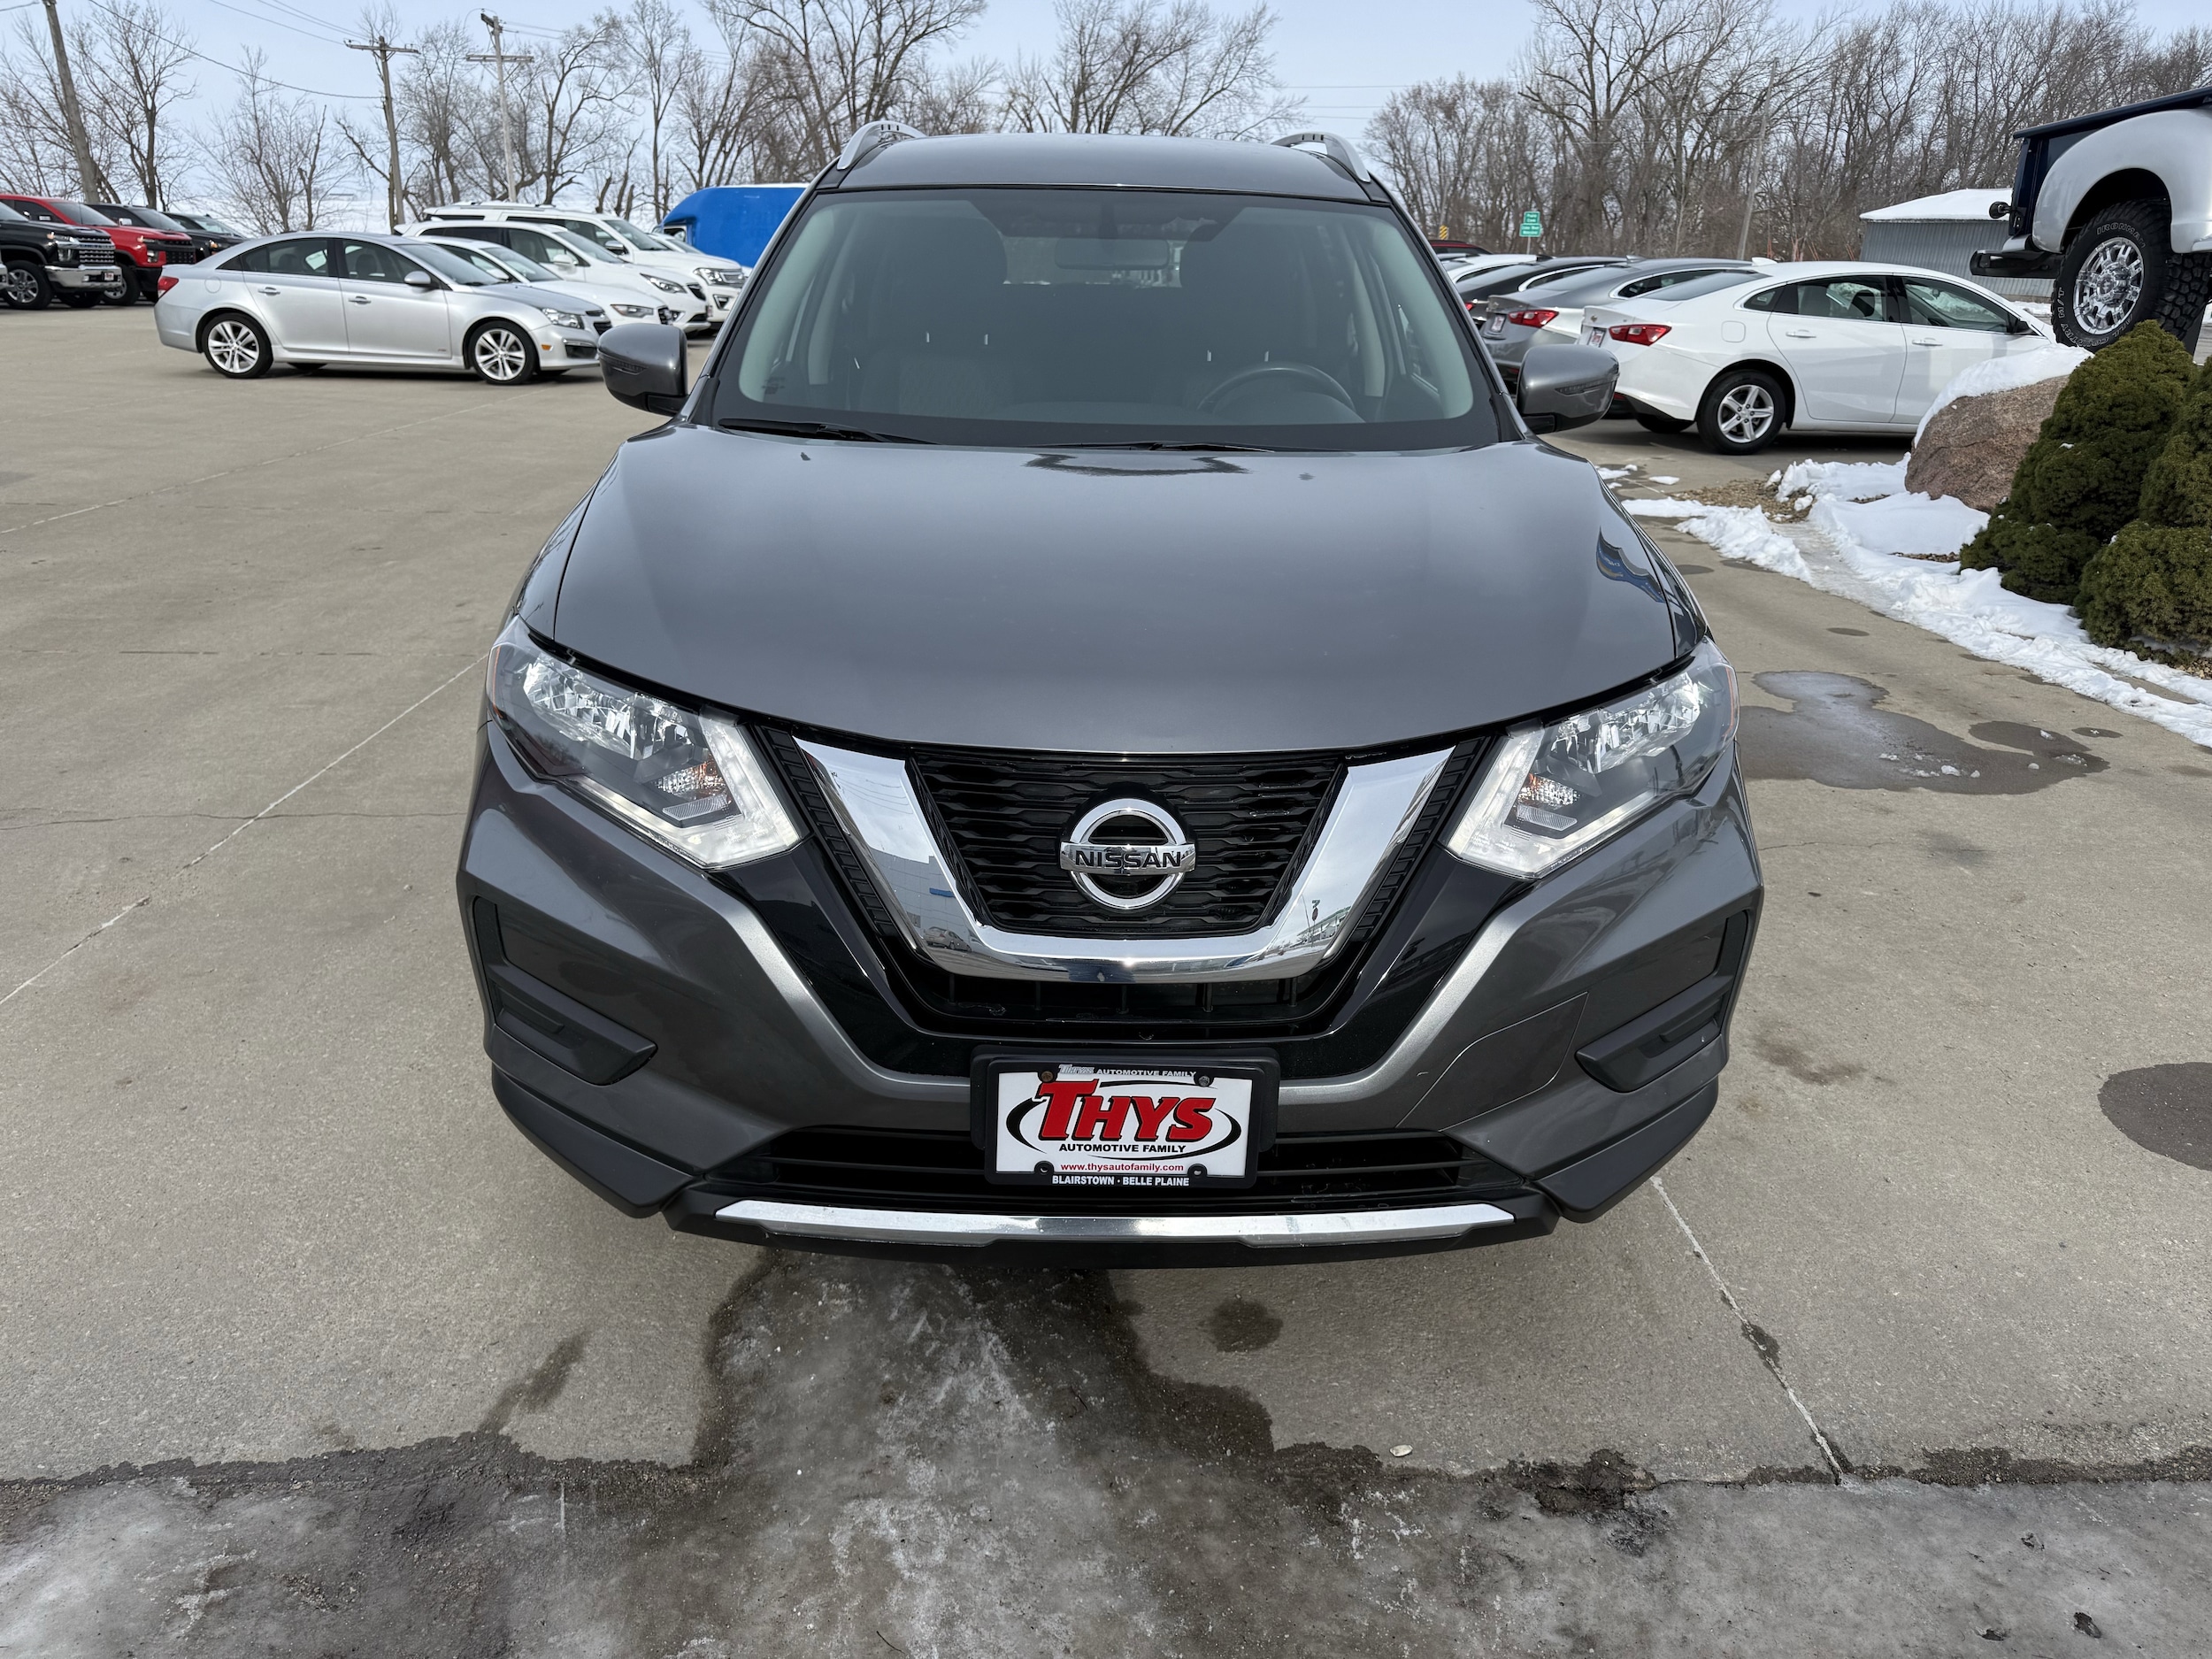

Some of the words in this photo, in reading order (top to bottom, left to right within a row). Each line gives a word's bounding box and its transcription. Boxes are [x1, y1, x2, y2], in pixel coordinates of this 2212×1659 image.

[2096, 222, 2146, 249] IRONMAN
[1075, 850, 1181, 868] NISSAN
[1033, 1079, 1216, 1142] THYS
[1059, 1144, 1139, 1153] AUTOMOTIVE
[1060, 1163, 1184, 1172] www.thysautofamily.com
[1052, 1175, 1115, 1186] BLAIRSTOWN
[1122, 1177, 1153, 1186] BELLE
[1155, 1177, 1189, 1187] PLAINE
